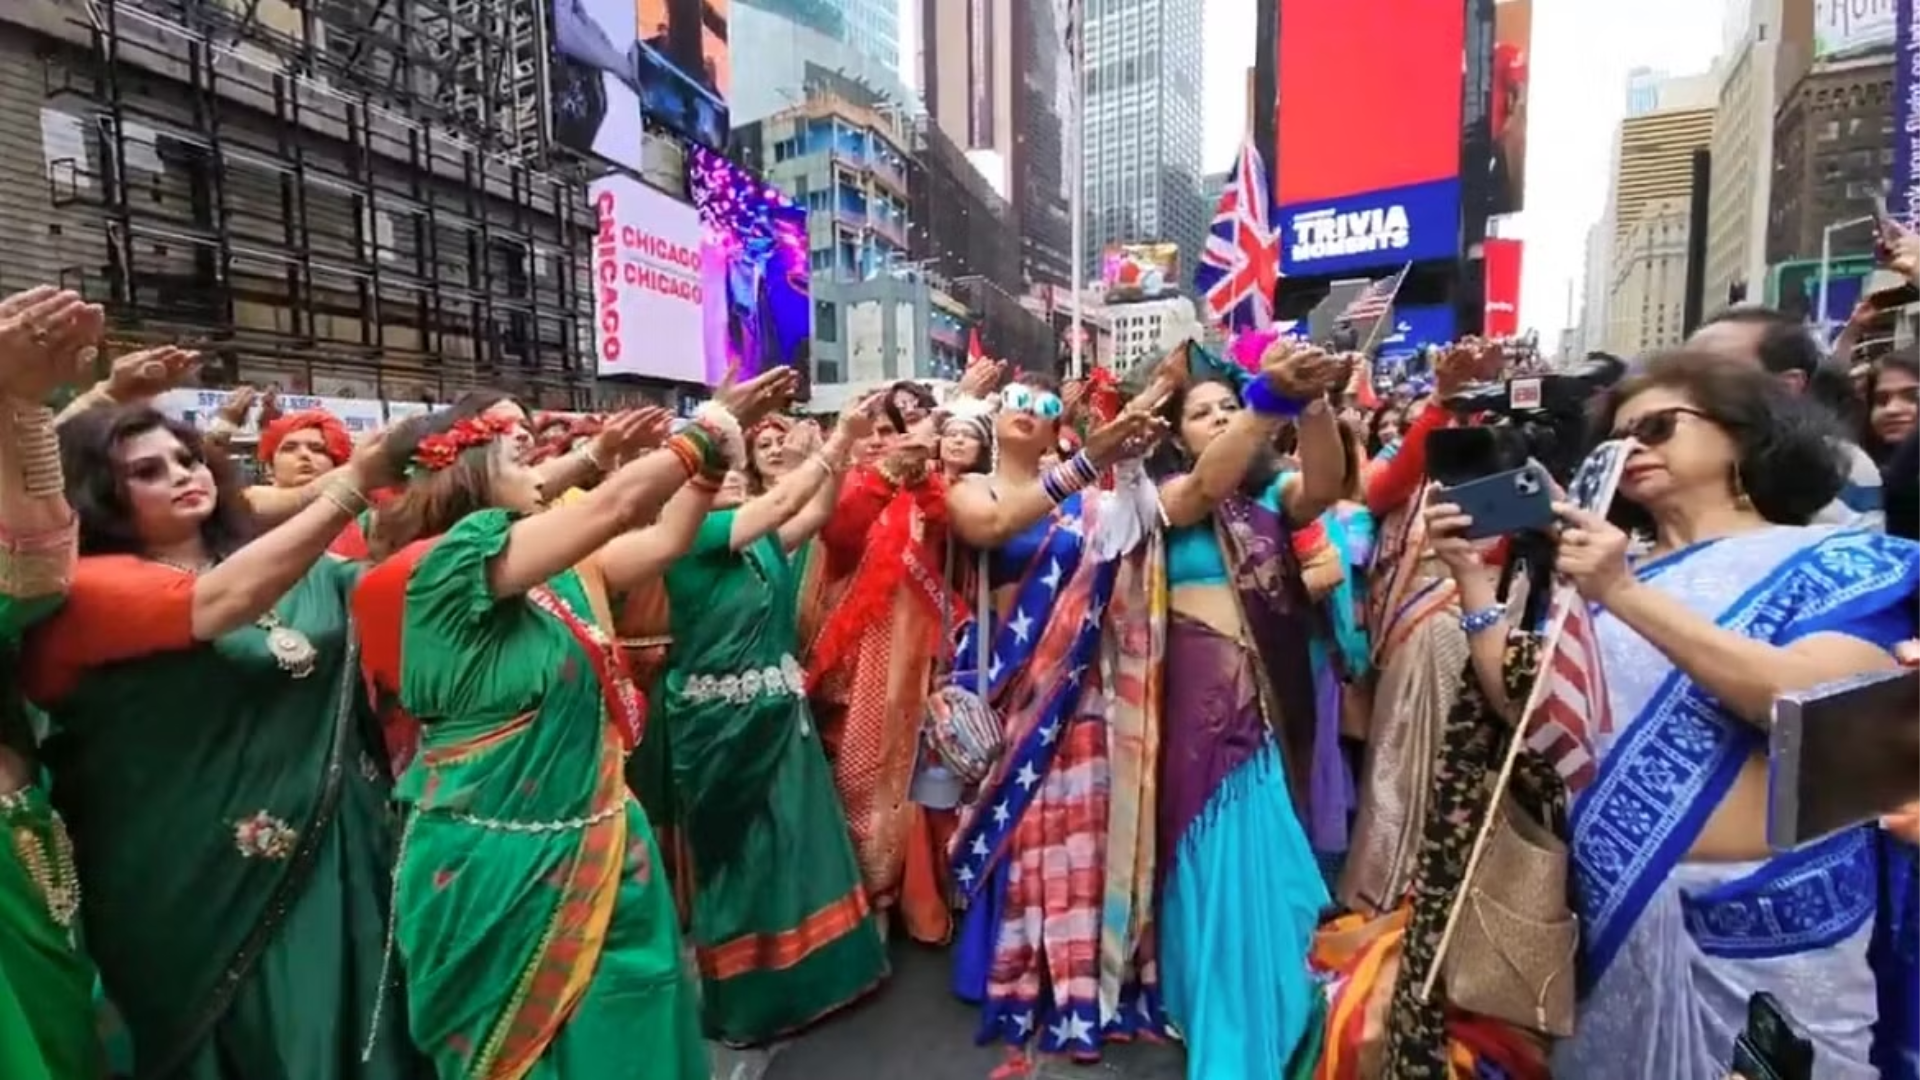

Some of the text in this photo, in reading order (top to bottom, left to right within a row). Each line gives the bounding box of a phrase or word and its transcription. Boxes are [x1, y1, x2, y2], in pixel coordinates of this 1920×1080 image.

[1293, 205, 1409, 244] TRIVIA
[622, 226, 702, 271] CHICAGO
[1292, 230, 1409, 261] MOMENTS
[598, 191, 620, 361] CHICAGO
[624, 263, 703, 304] CHICAGO
